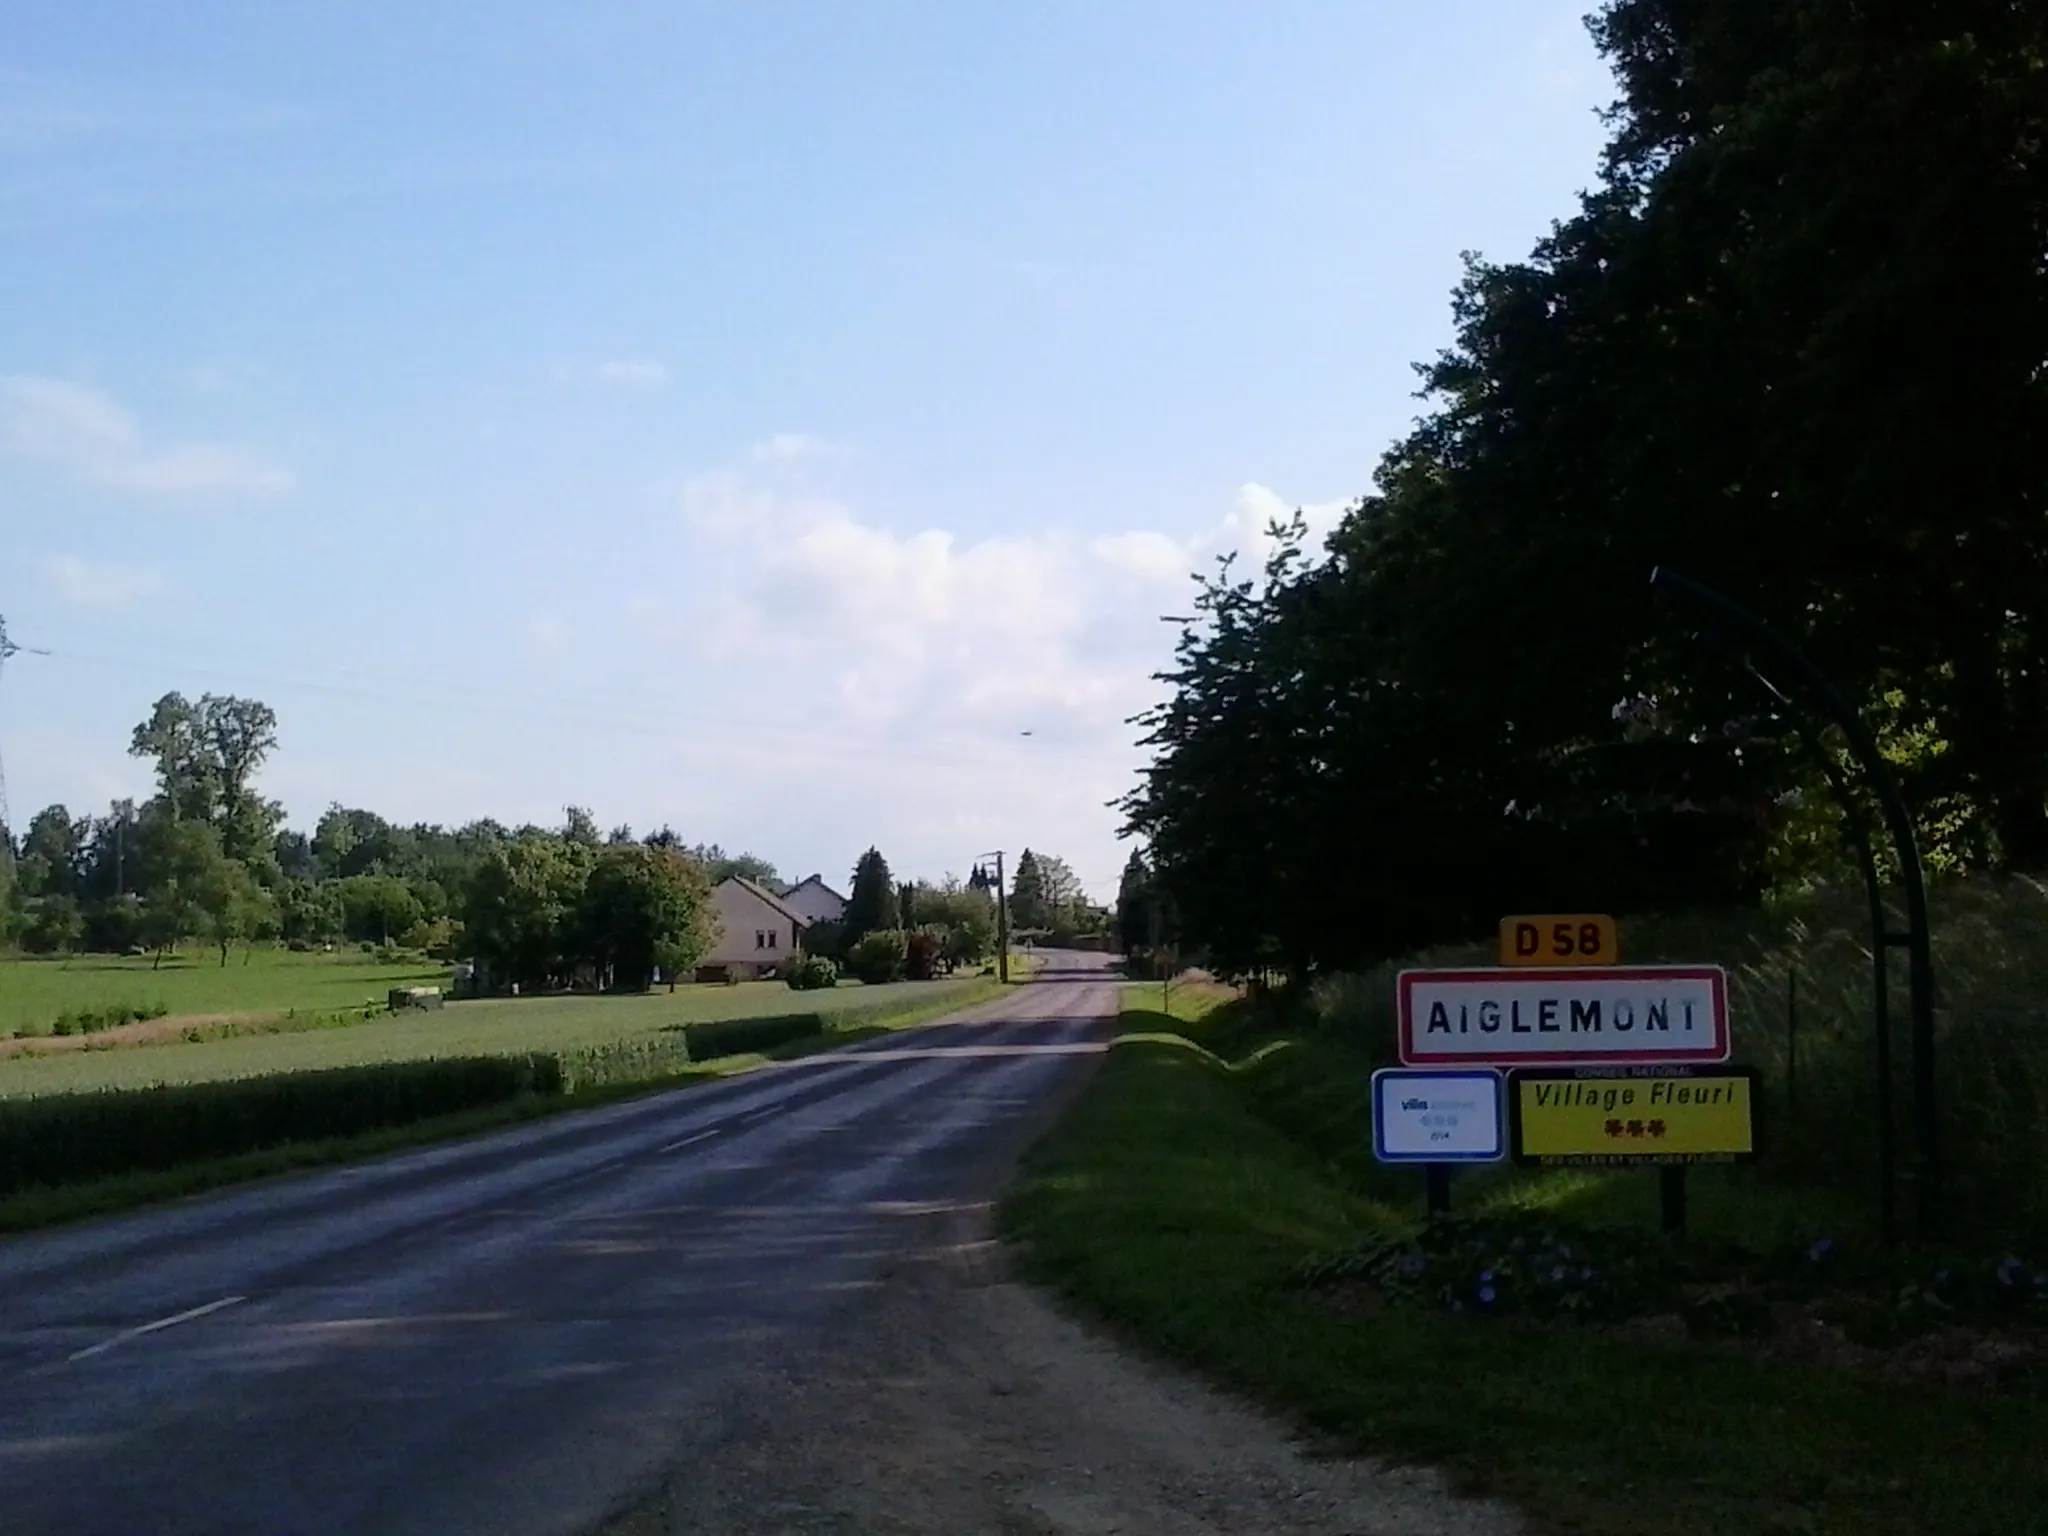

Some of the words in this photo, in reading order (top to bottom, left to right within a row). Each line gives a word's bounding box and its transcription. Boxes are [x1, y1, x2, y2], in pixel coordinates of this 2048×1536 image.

[1515, 922, 1540, 956] D
[1552, 922, 1601, 956] 58
[1426, 997, 1699, 1034] AIGLEMONT
[1535, 1083, 1636, 1111] Village
[1650, 1081, 1735, 1105] Fleuri
